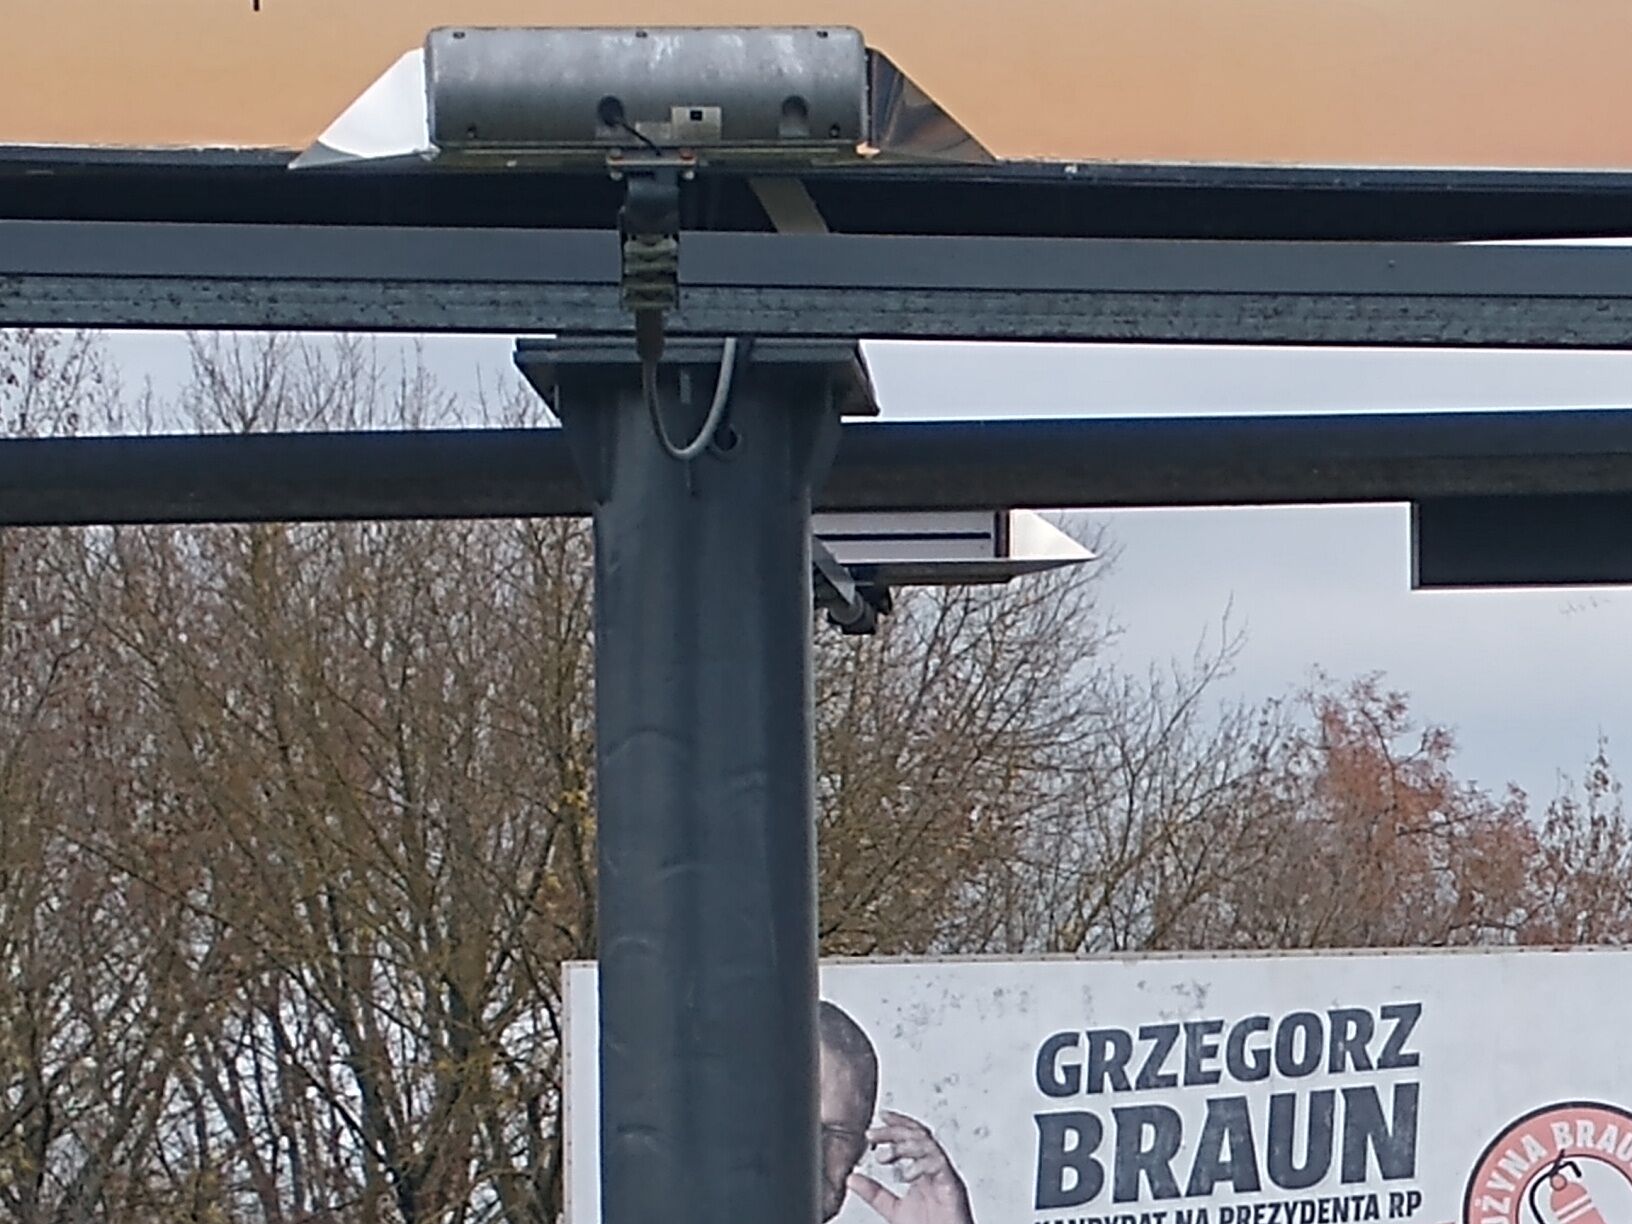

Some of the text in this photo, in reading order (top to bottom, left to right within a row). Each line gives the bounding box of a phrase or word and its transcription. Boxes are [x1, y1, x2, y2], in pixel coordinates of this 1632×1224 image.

[1036, 1003, 1422, 1098] GRZEGORZ
[1034, 1082, 1421, 1210] BRAUN
[1388, 1190, 1422, 1219] RP
